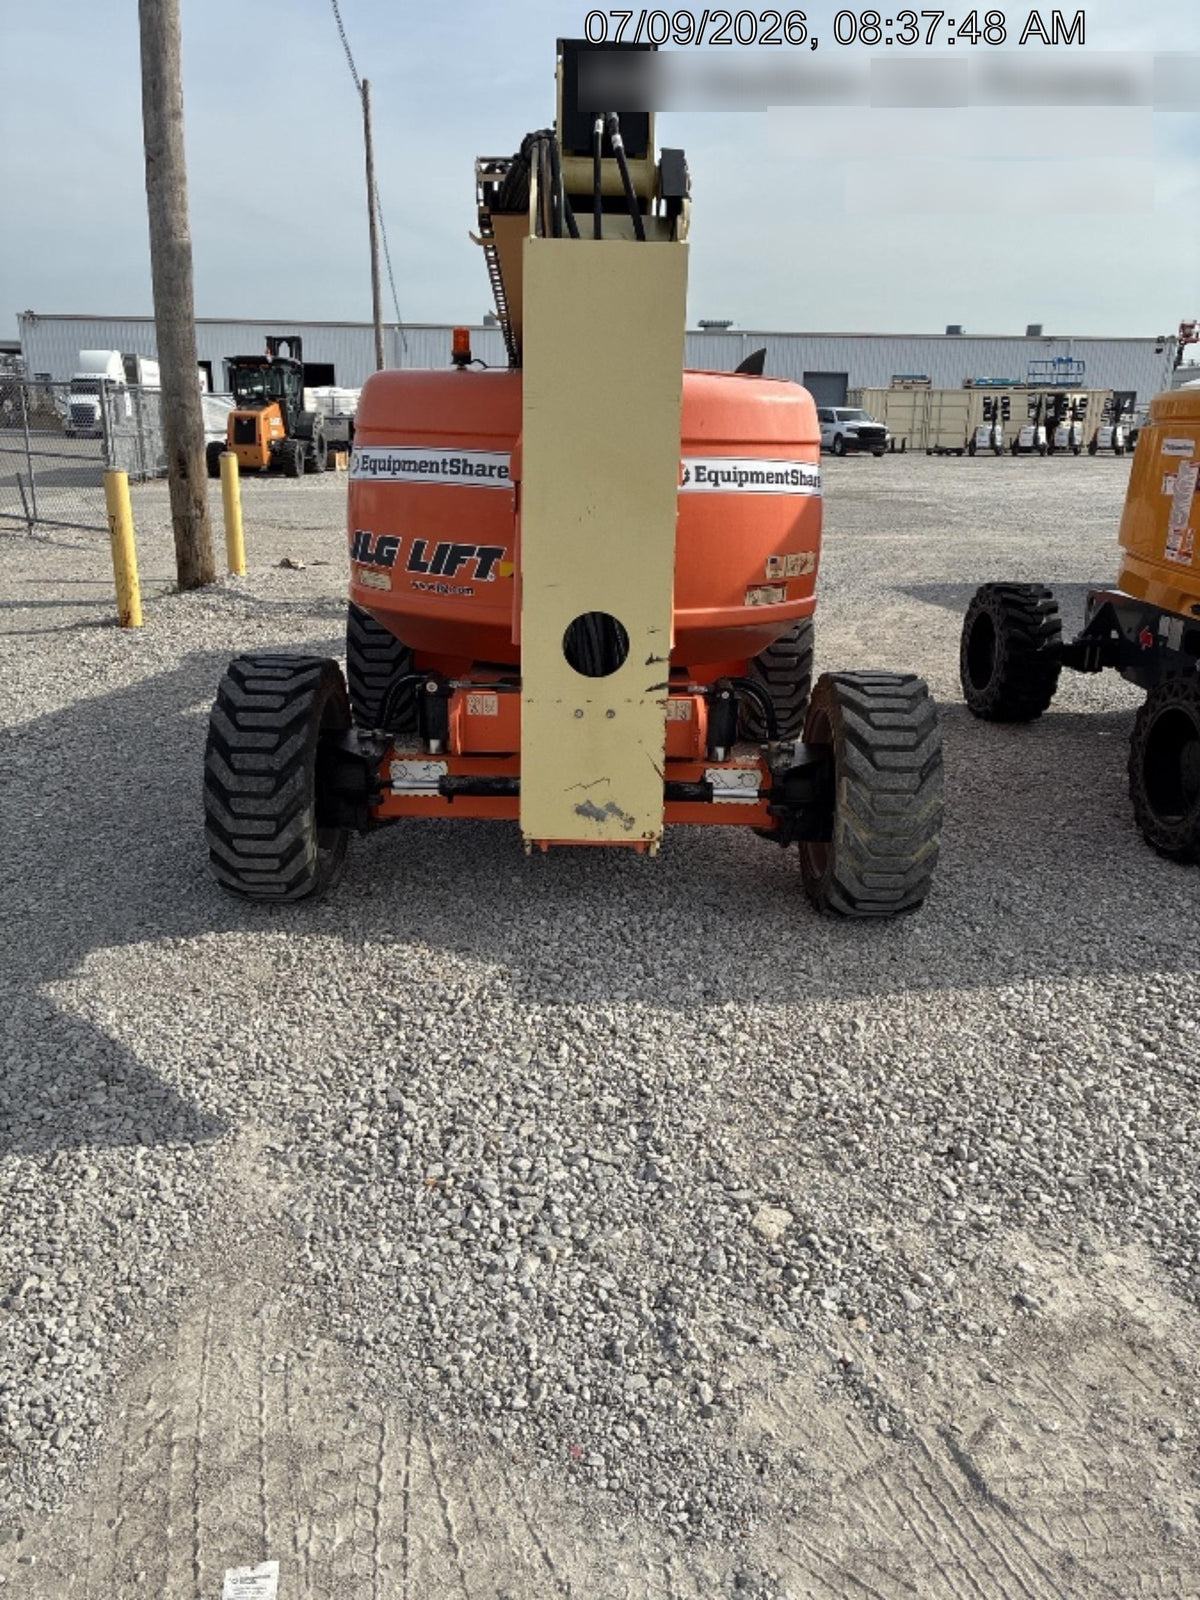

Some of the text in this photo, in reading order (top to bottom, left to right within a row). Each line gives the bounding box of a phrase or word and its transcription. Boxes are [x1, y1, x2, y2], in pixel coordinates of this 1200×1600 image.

[360, 454, 509, 479] EquipmentShare
[351, 529, 402, 569] JLG
[405, 538, 507, 582] LIFT
